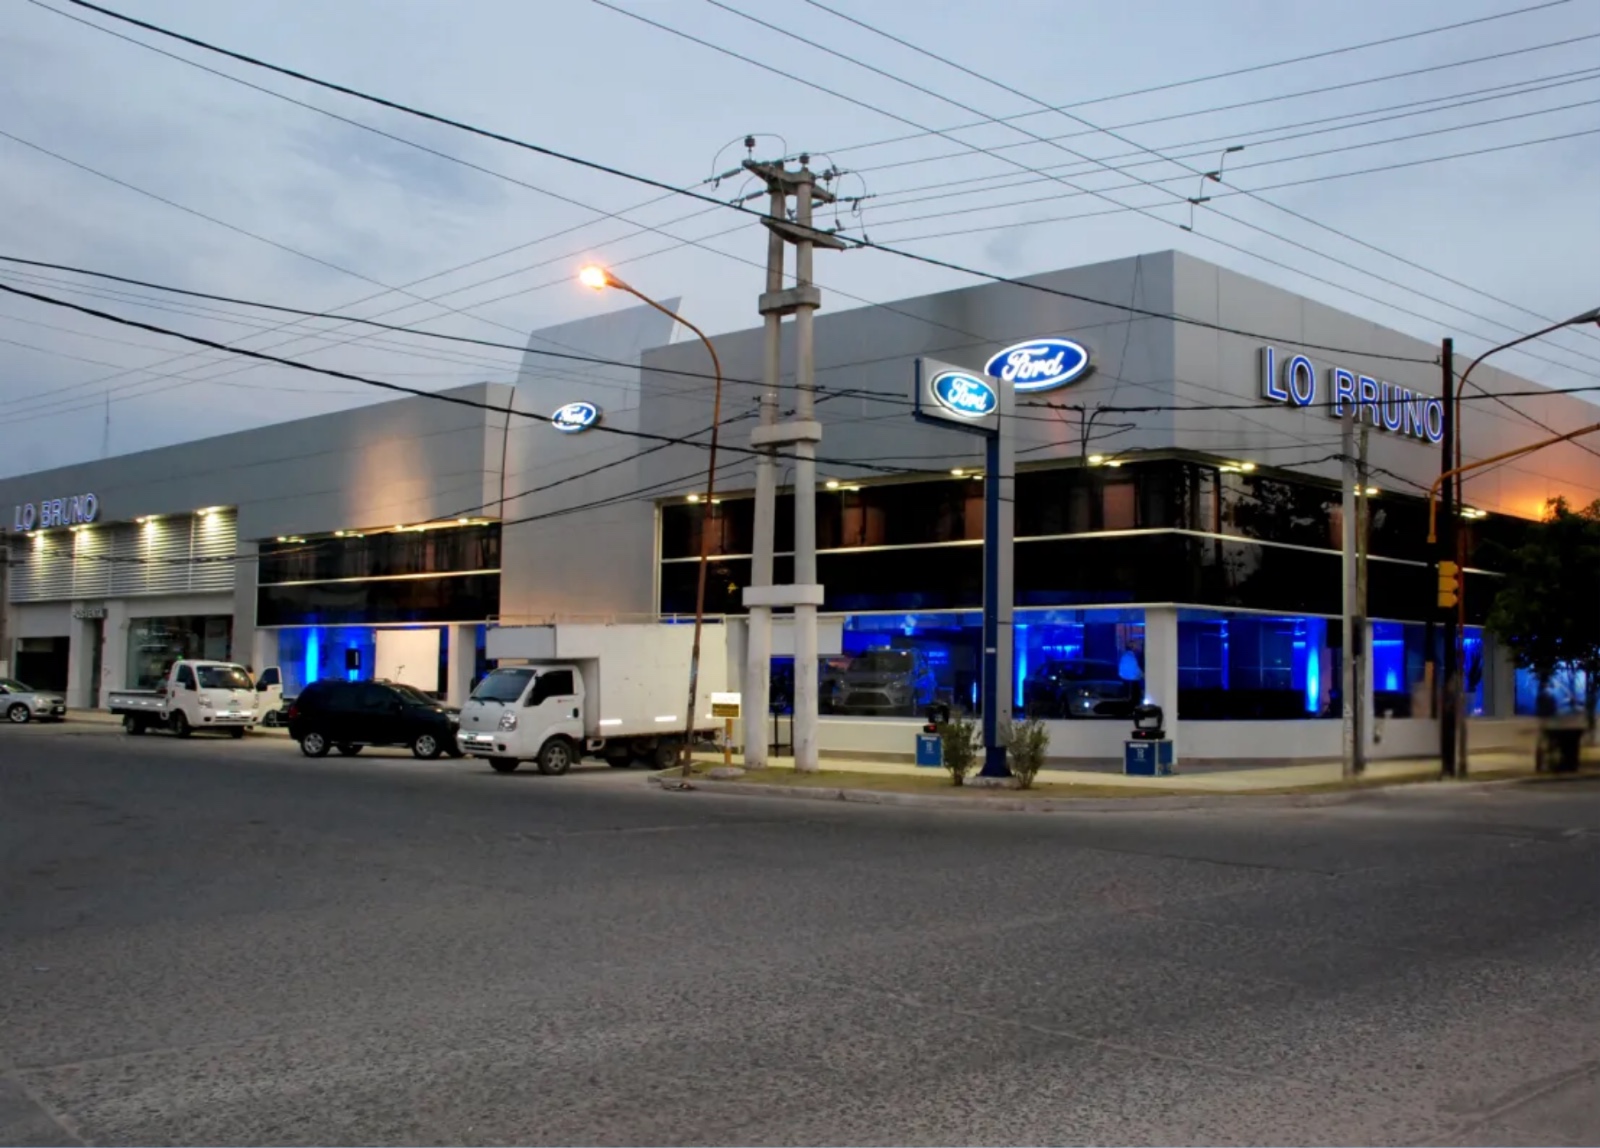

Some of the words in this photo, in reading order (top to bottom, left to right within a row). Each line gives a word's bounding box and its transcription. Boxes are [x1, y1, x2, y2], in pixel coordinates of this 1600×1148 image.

[1001, 346, 1065, 382] Ford
[947, 377, 988, 411] Ford
[1265, 346, 1316, 407] LO
[1332, 367, 1444, 443] BRUNO
[15, 503, 36, 532] LO
[41, 493, 98, 527] BRUNO
